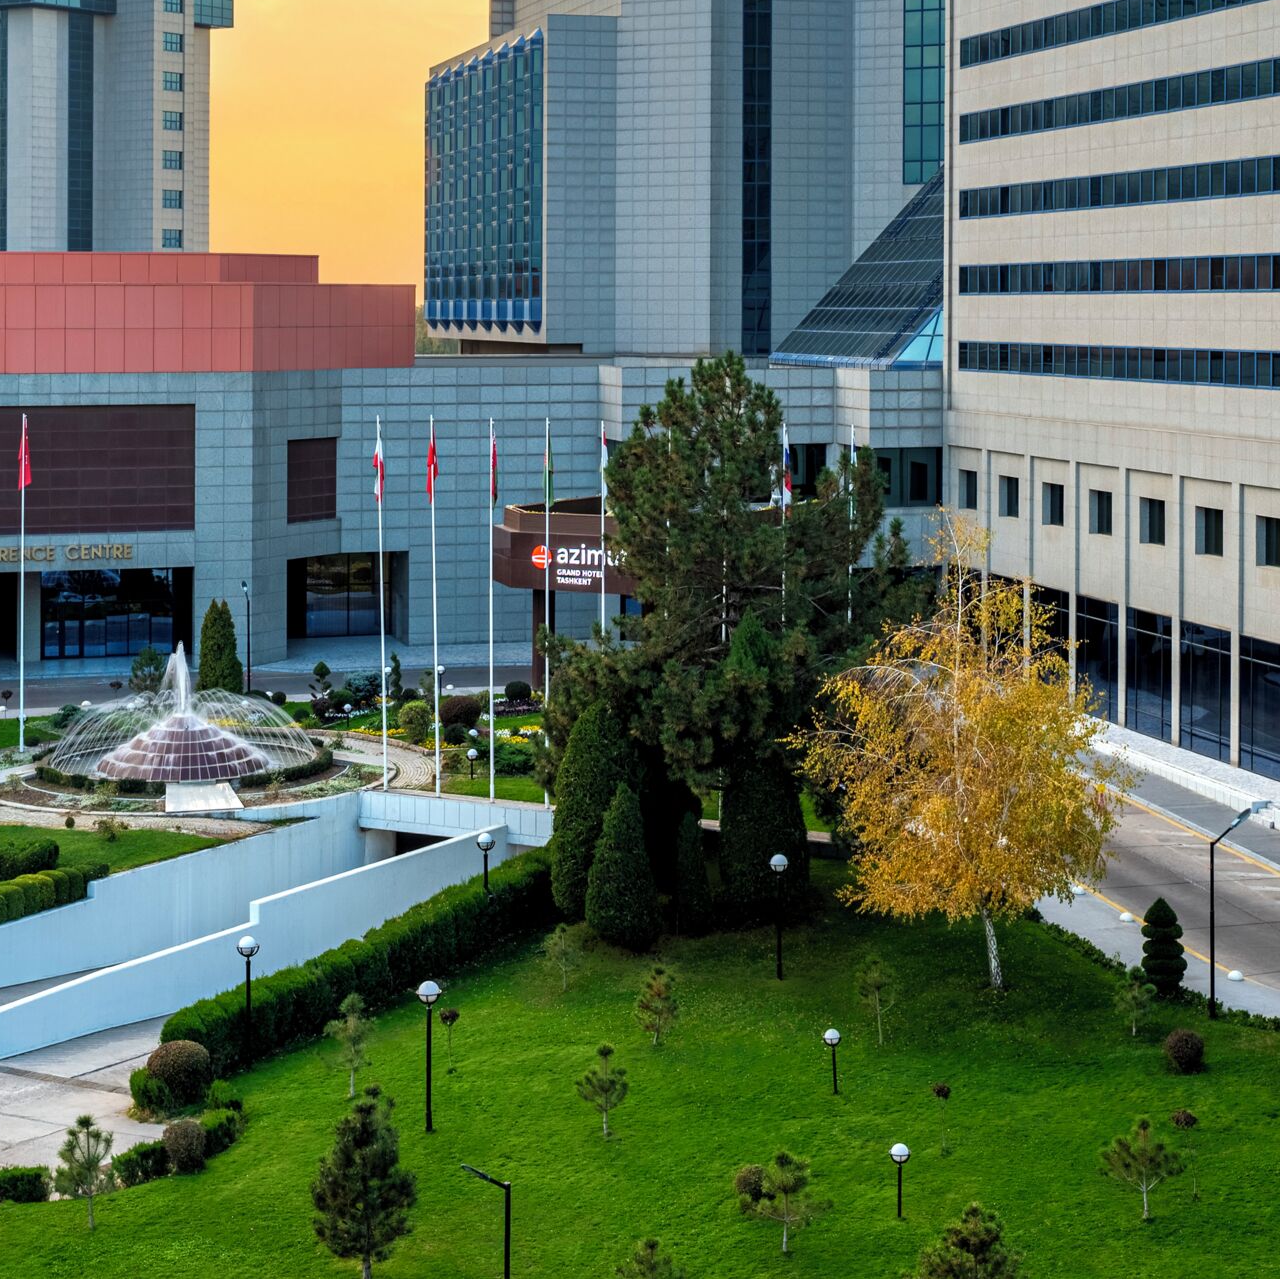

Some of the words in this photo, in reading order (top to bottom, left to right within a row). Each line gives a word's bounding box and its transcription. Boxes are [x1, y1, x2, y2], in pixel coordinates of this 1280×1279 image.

[65, 543, 133, 560] CENTRE
[556, 569, 581, 577] GRAND
[556, 577, 592, 586] TASHKENT
